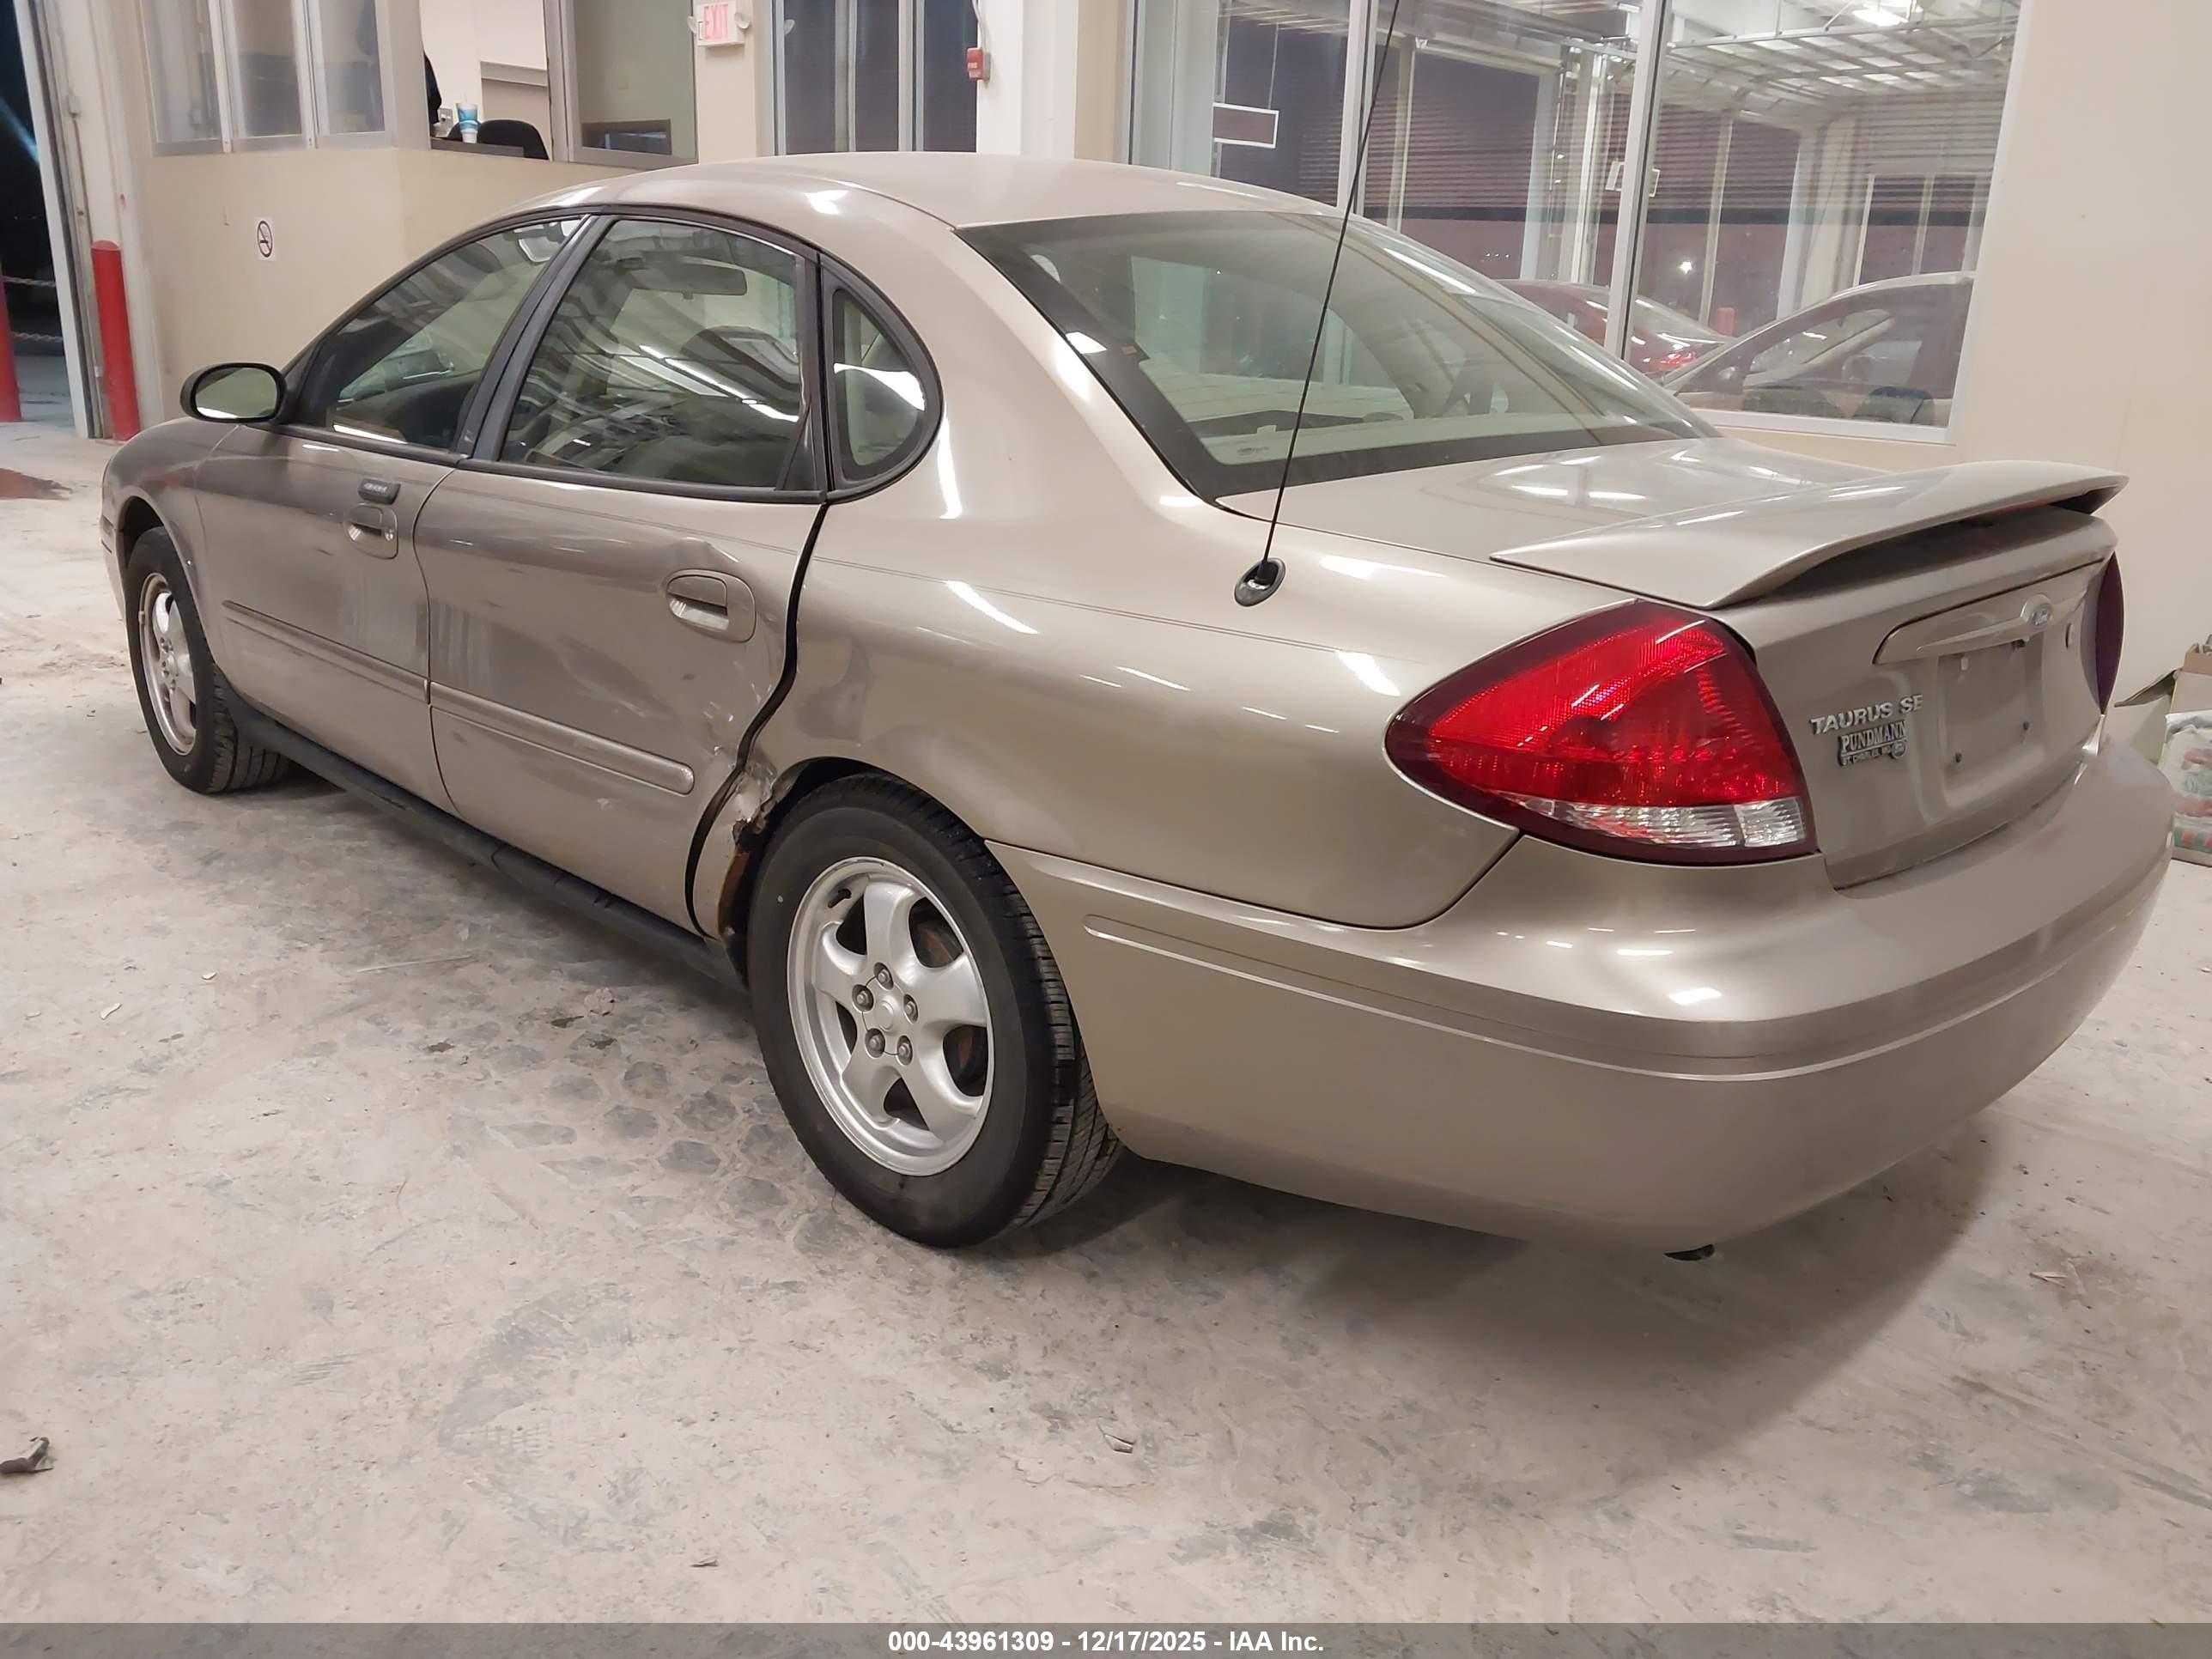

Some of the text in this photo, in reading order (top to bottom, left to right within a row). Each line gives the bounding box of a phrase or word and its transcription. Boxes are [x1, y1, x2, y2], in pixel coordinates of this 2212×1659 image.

[703, 3, 729, 40] EXIT
[1809, 694, 1923, 734] TAURUS SE
[1839, 720, 1907, 754] PUNDMANN
